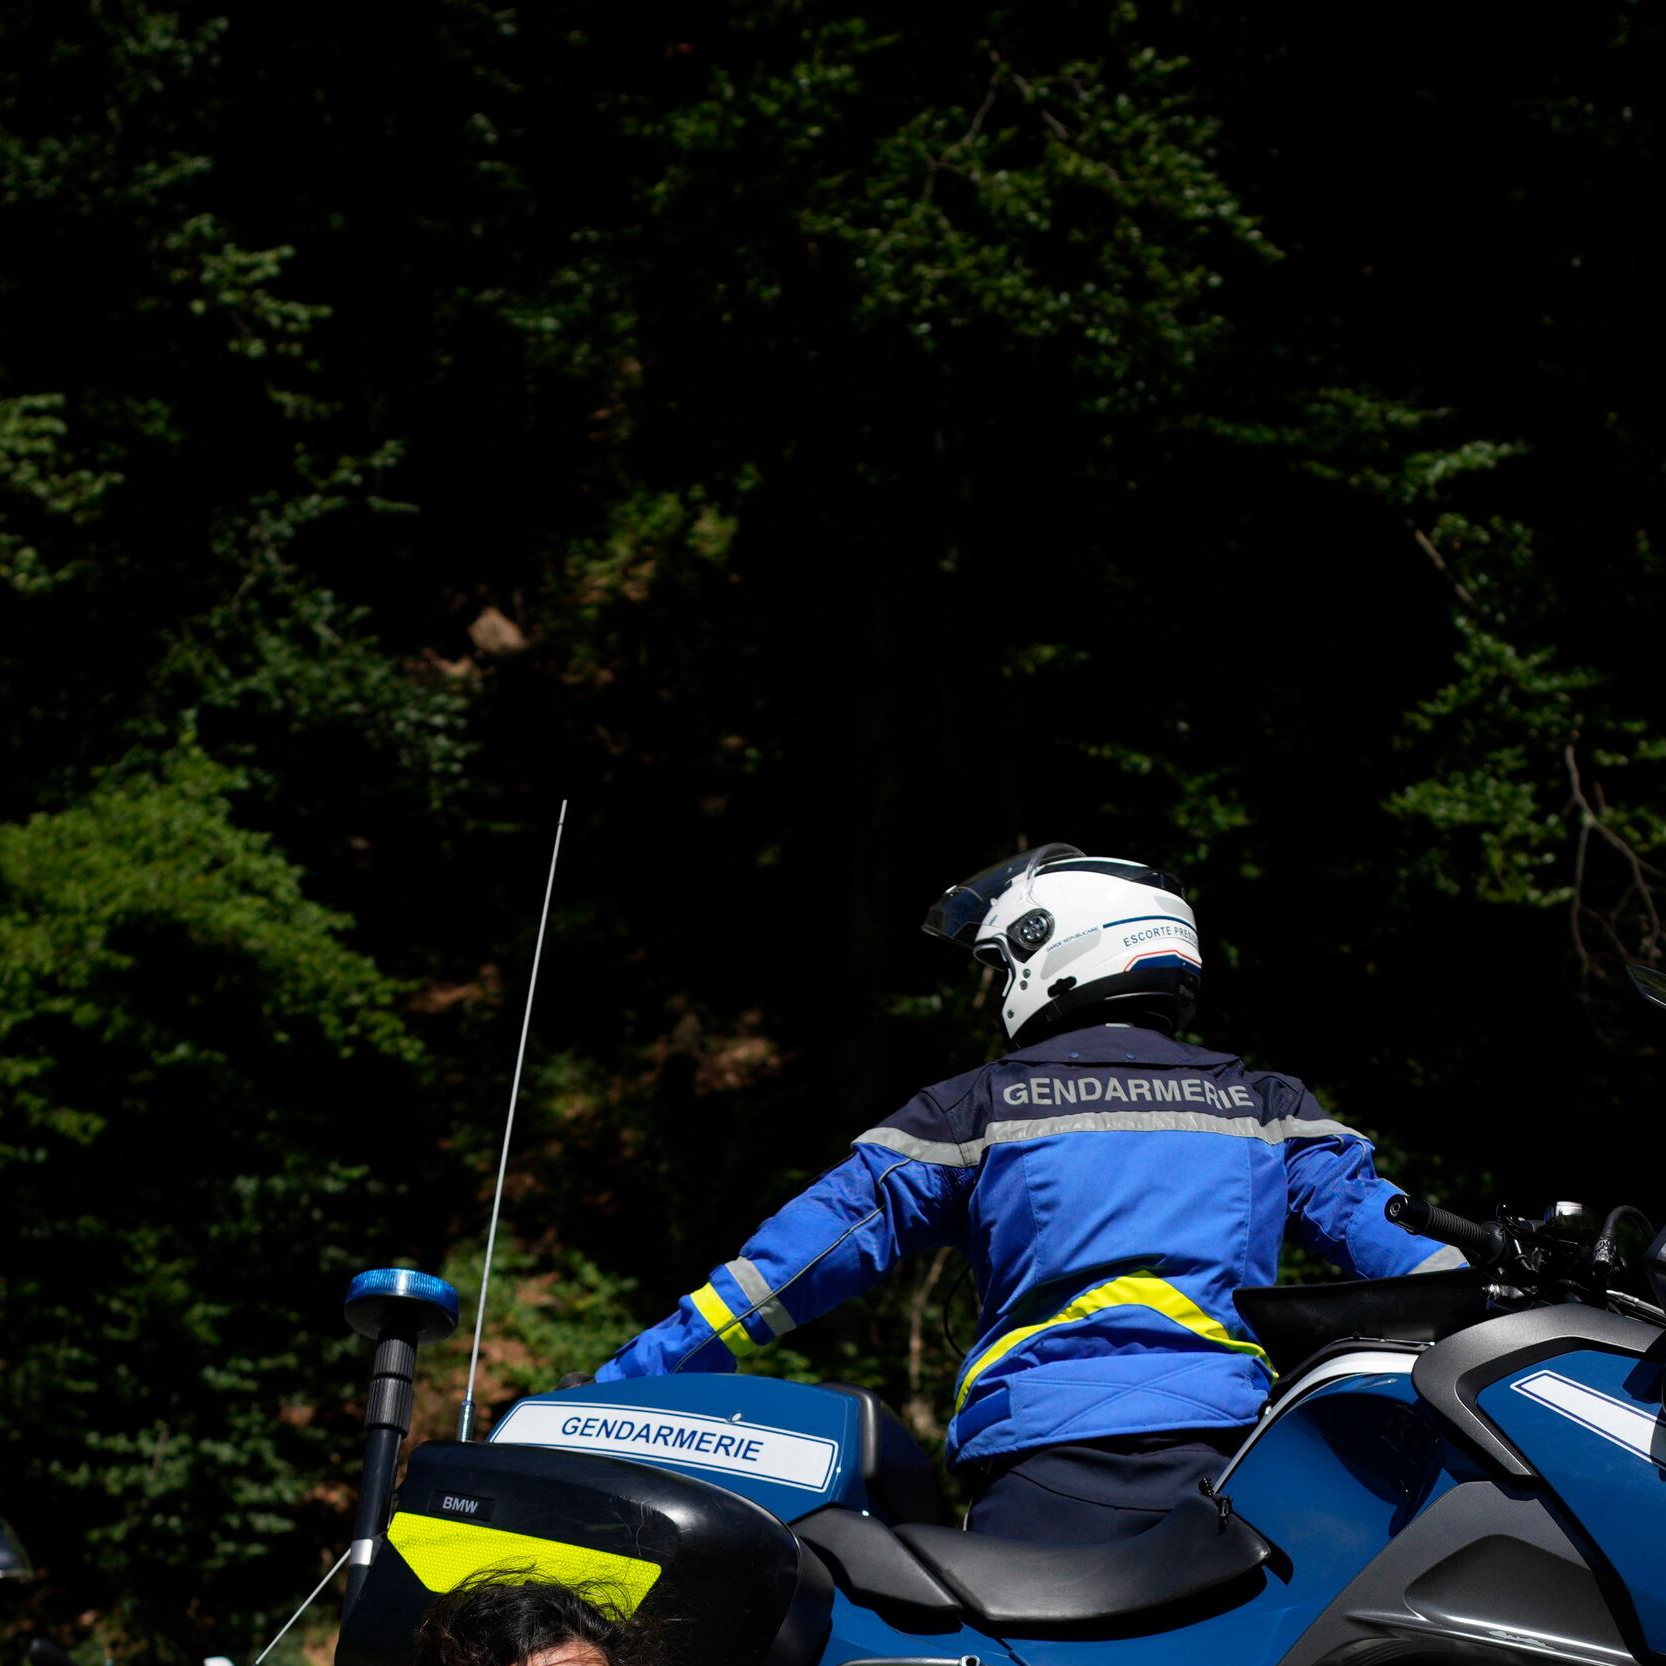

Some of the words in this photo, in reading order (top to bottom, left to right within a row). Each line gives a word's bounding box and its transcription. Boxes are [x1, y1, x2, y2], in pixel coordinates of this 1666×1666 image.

[1123, 926, 1172, 947] ESCORTE
[1003, 1077, 1254, 1110] GENDARMERIE
[561, 1416, 764, 1462] GENDARMERIE
[442, 1496, 479, 1514] BMW
